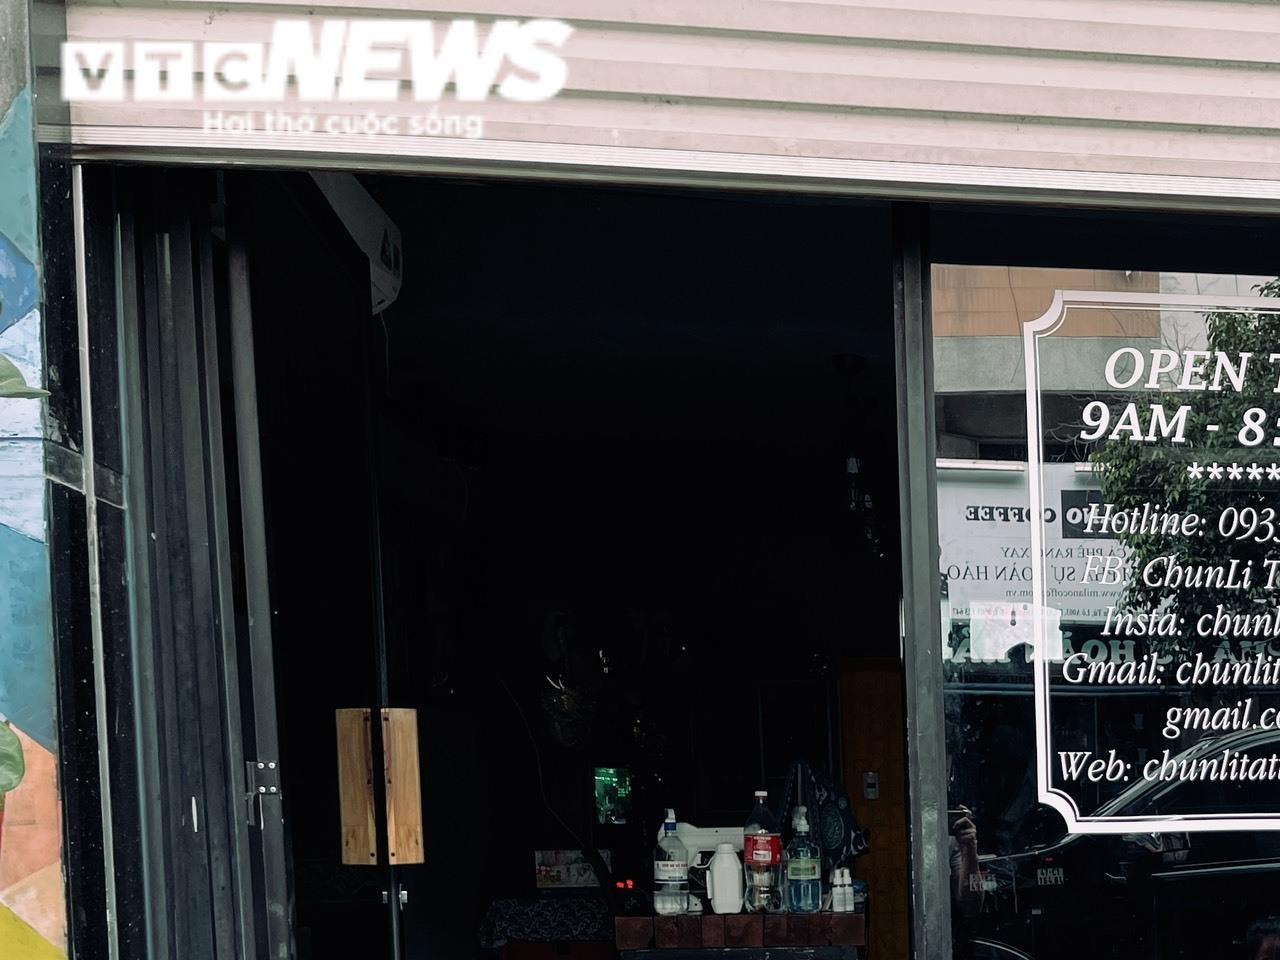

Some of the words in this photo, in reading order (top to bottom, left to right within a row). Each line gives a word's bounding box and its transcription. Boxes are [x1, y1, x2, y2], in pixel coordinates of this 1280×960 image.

[1104, 347, 1252, 393] OPEN
[1080, 400, 1191, 443] 9AM
[1083, 502, 1206, 537] Hotline:
[1143, 554, 1254, 591] ChunLi
[1100, 605, 1186, 637] Insta:
[1062, 652, 1165, 685] Gmail:
[1058, 750, 1132, 782] Web:
